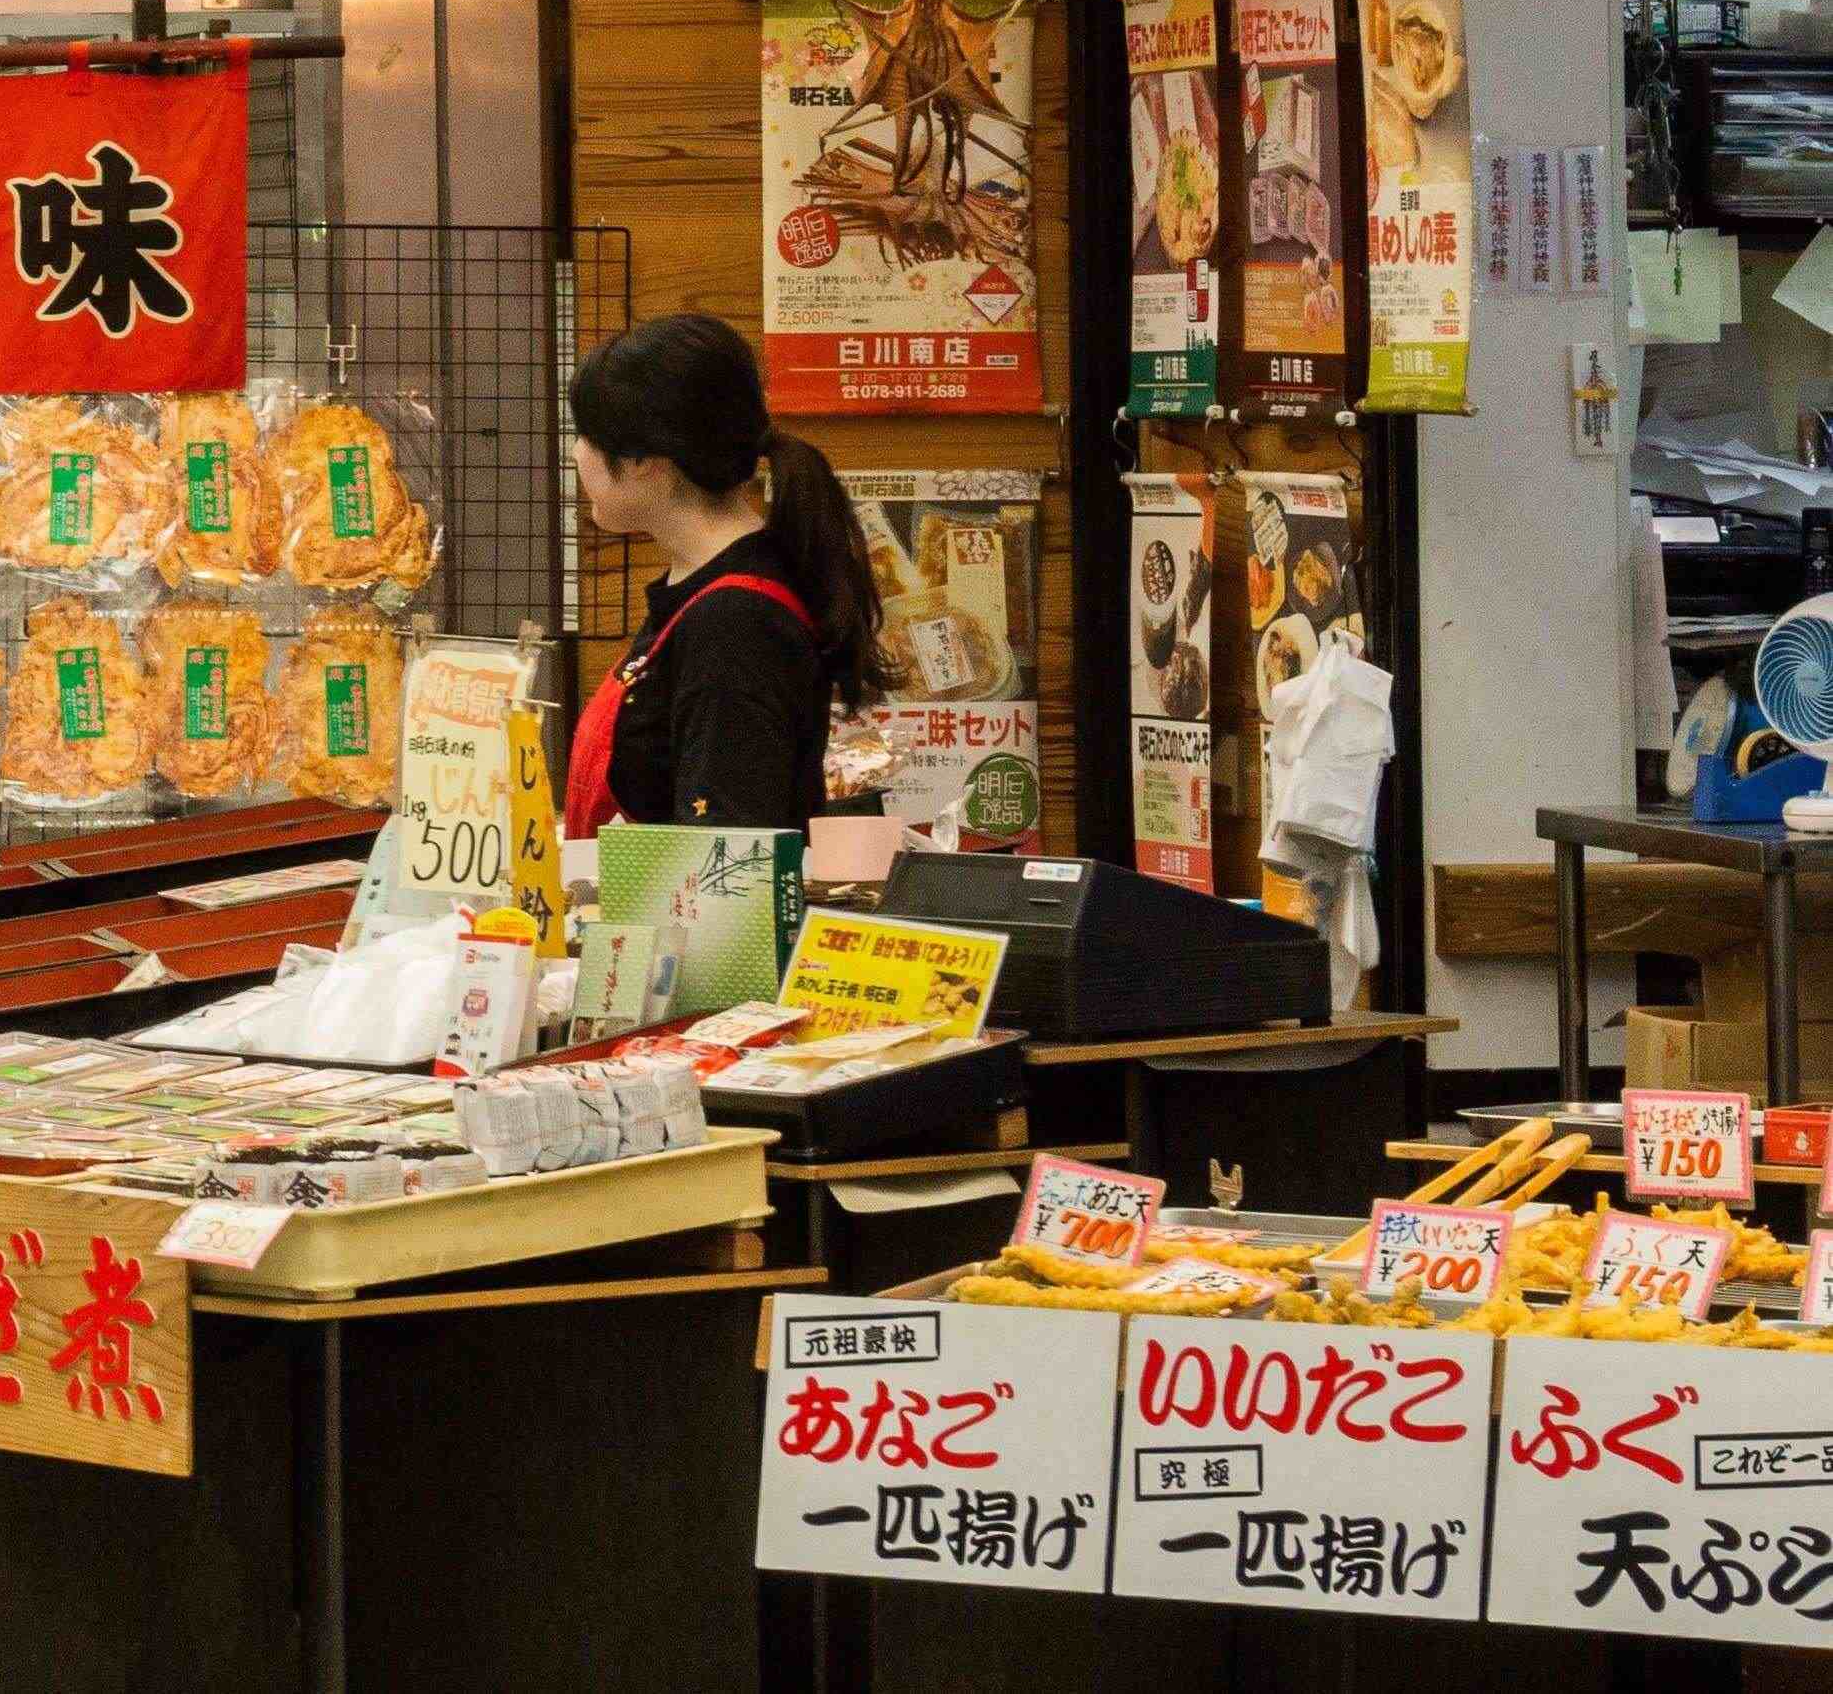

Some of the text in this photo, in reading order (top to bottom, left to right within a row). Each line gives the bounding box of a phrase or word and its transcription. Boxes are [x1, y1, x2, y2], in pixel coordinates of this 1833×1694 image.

[839, 338, 971, 364] 白川南店
[860, 384, 967, 399] 078-911-2689
[411, 820, 502, 887] 500
[518, 743, 552, 941] じん粉
[1640, 1137, 1723, 1178] ¥150
[1381, 1249, 1482, 1294] ¥200
[803, 1323, 916, 1360] 元祖豪快
[778, 1376, 1016, 1470] あなご
[1137, 1336, 1466, 1444] いいだこ
[1511, 1384, 1701, 1484] ふぐ
[1159, 1456, 1234, 1491] 究極
[800, 1482, 1094, 1572] 一匹揚げ
[1157, 1513, 1468, 1600] 一匹揚げ
[1575, 1513, 1833, 1624] 天ぷら
